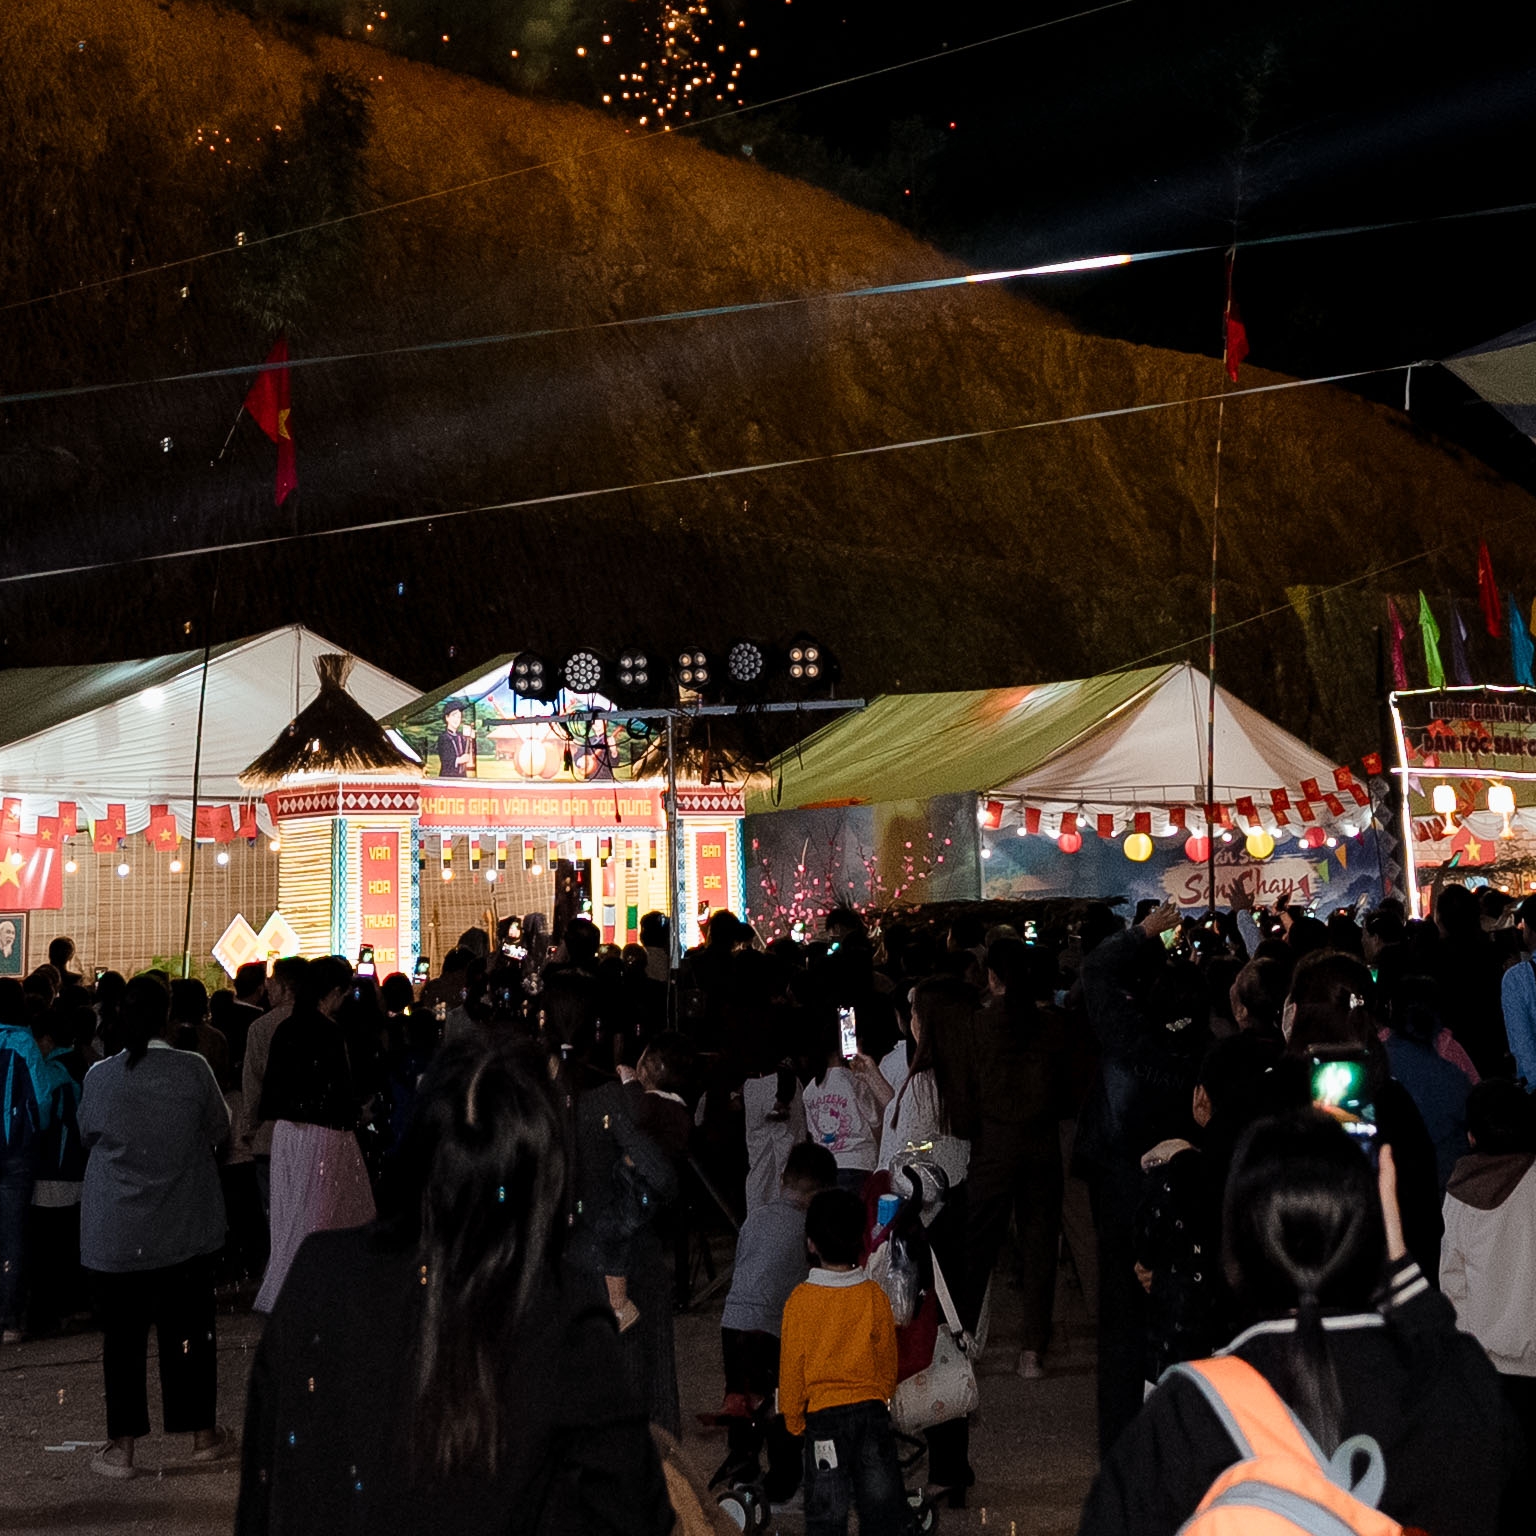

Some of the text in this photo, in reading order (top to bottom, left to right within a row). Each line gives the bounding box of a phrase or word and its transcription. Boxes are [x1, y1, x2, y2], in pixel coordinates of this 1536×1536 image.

[421, 794, 465, 815] KHÔNG
[468, 798, 499, 815] GIAN
[503, 796, 529, 815] VĂN
[592, 796, 616, 818] TỘC
